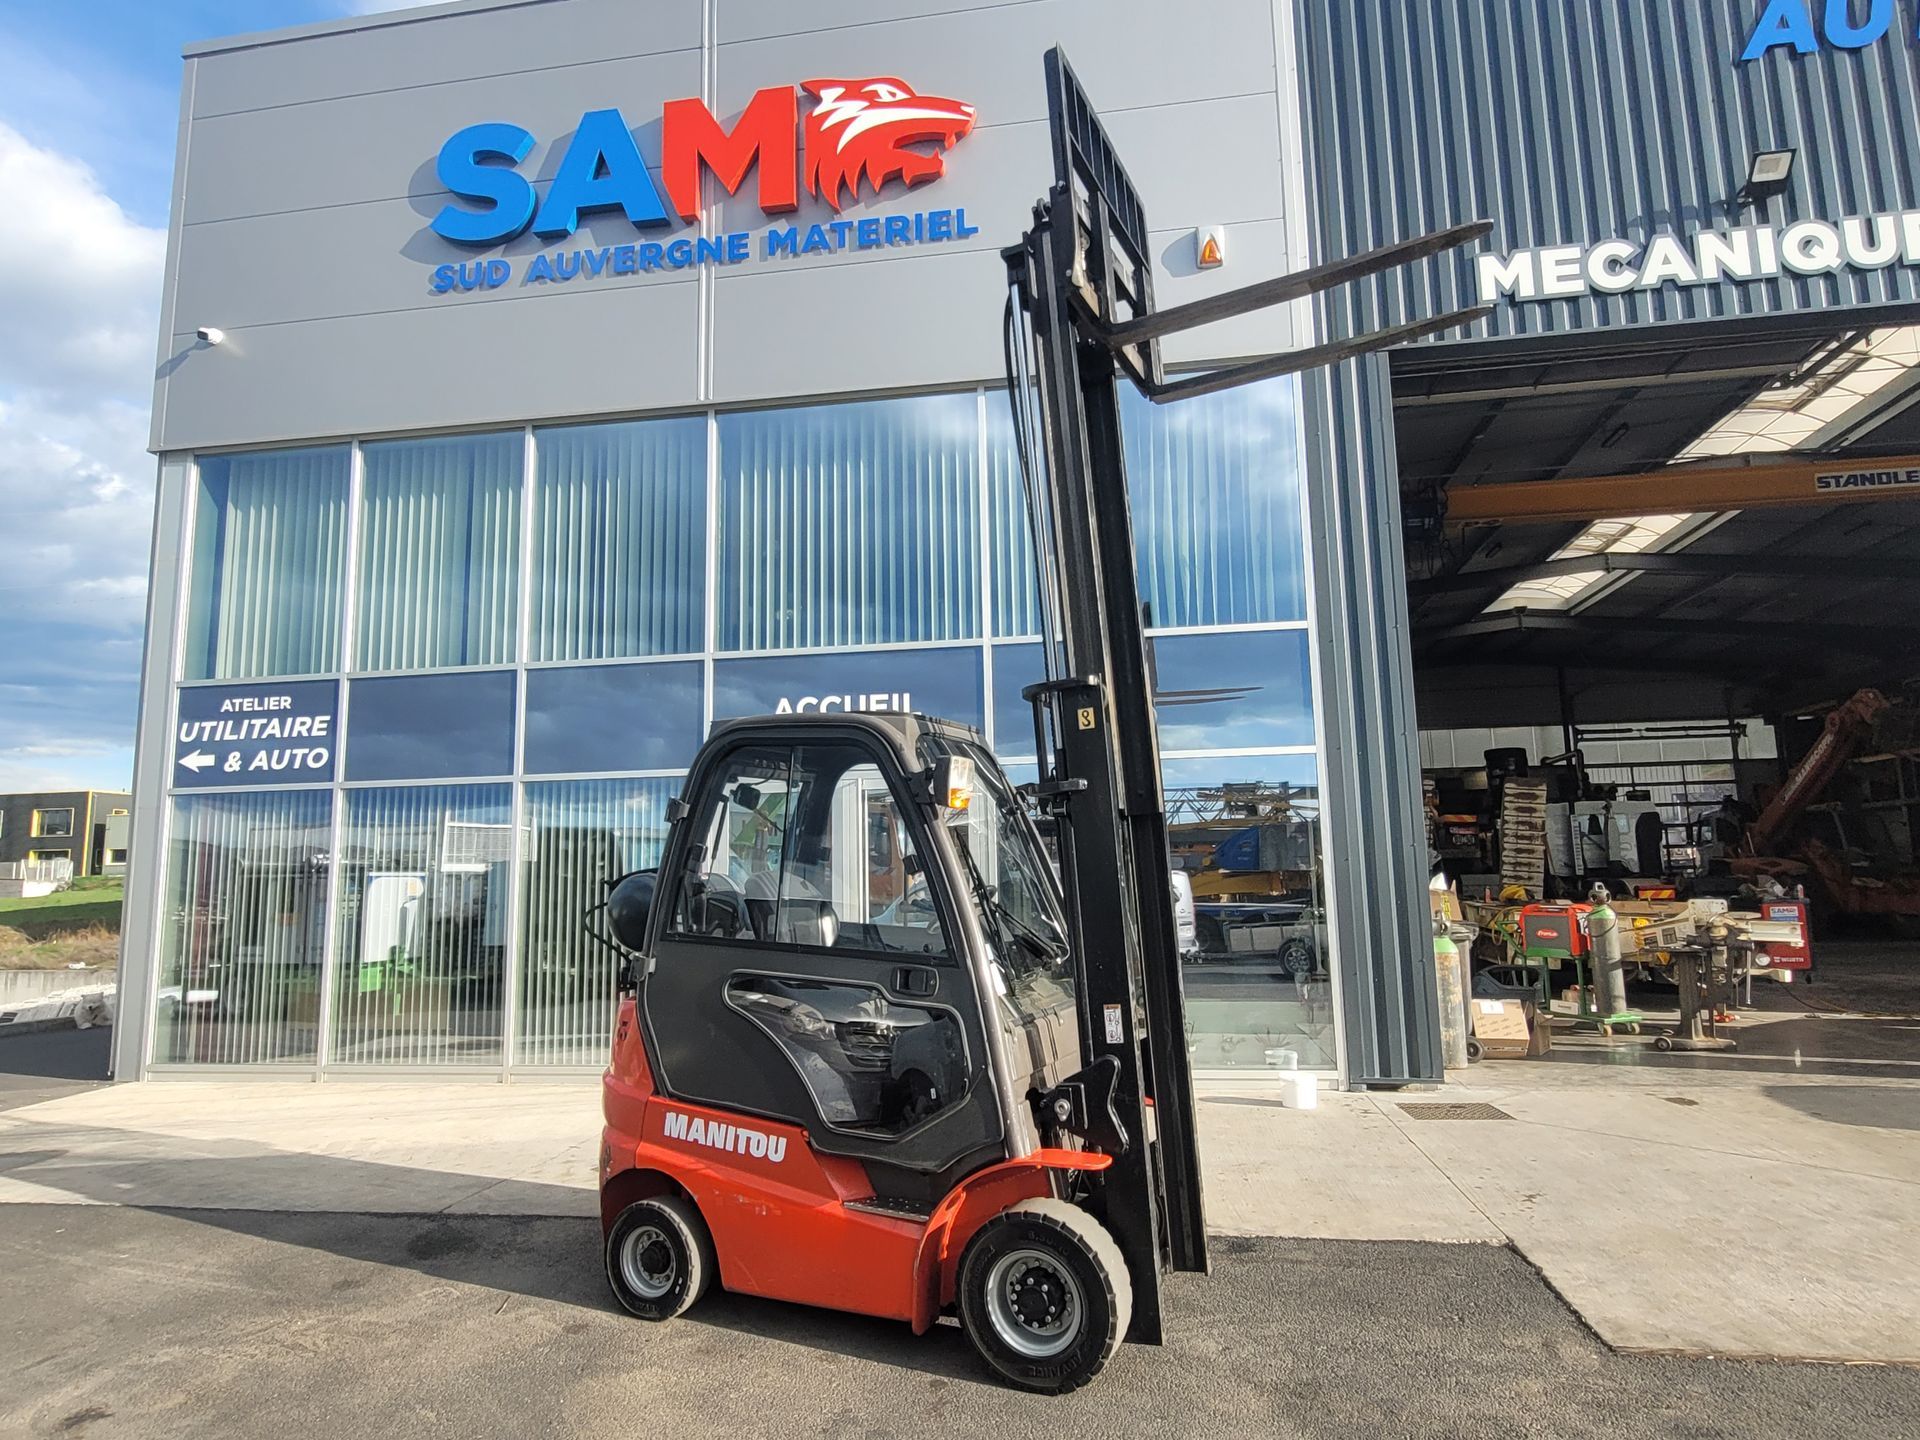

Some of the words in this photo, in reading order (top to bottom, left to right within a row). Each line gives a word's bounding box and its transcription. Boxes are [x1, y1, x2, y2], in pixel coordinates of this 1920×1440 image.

[1740, 0, 1920, 60] AU
[430, 85, 798, 246] SAM
[433, 260, 511, 293] SUD
[526, 234, 750, 283] AUVERGNE
[768, 209, 979, 256] MATERIEL
[180, 715, 331, 743] UTILITAIRE
[220, 696, 292, 713] ATELIER
[223, 751, 242, 773] &
[248, 747, 329, 771] AUTO
[664, 1112, 787, 1162] MANITOU
